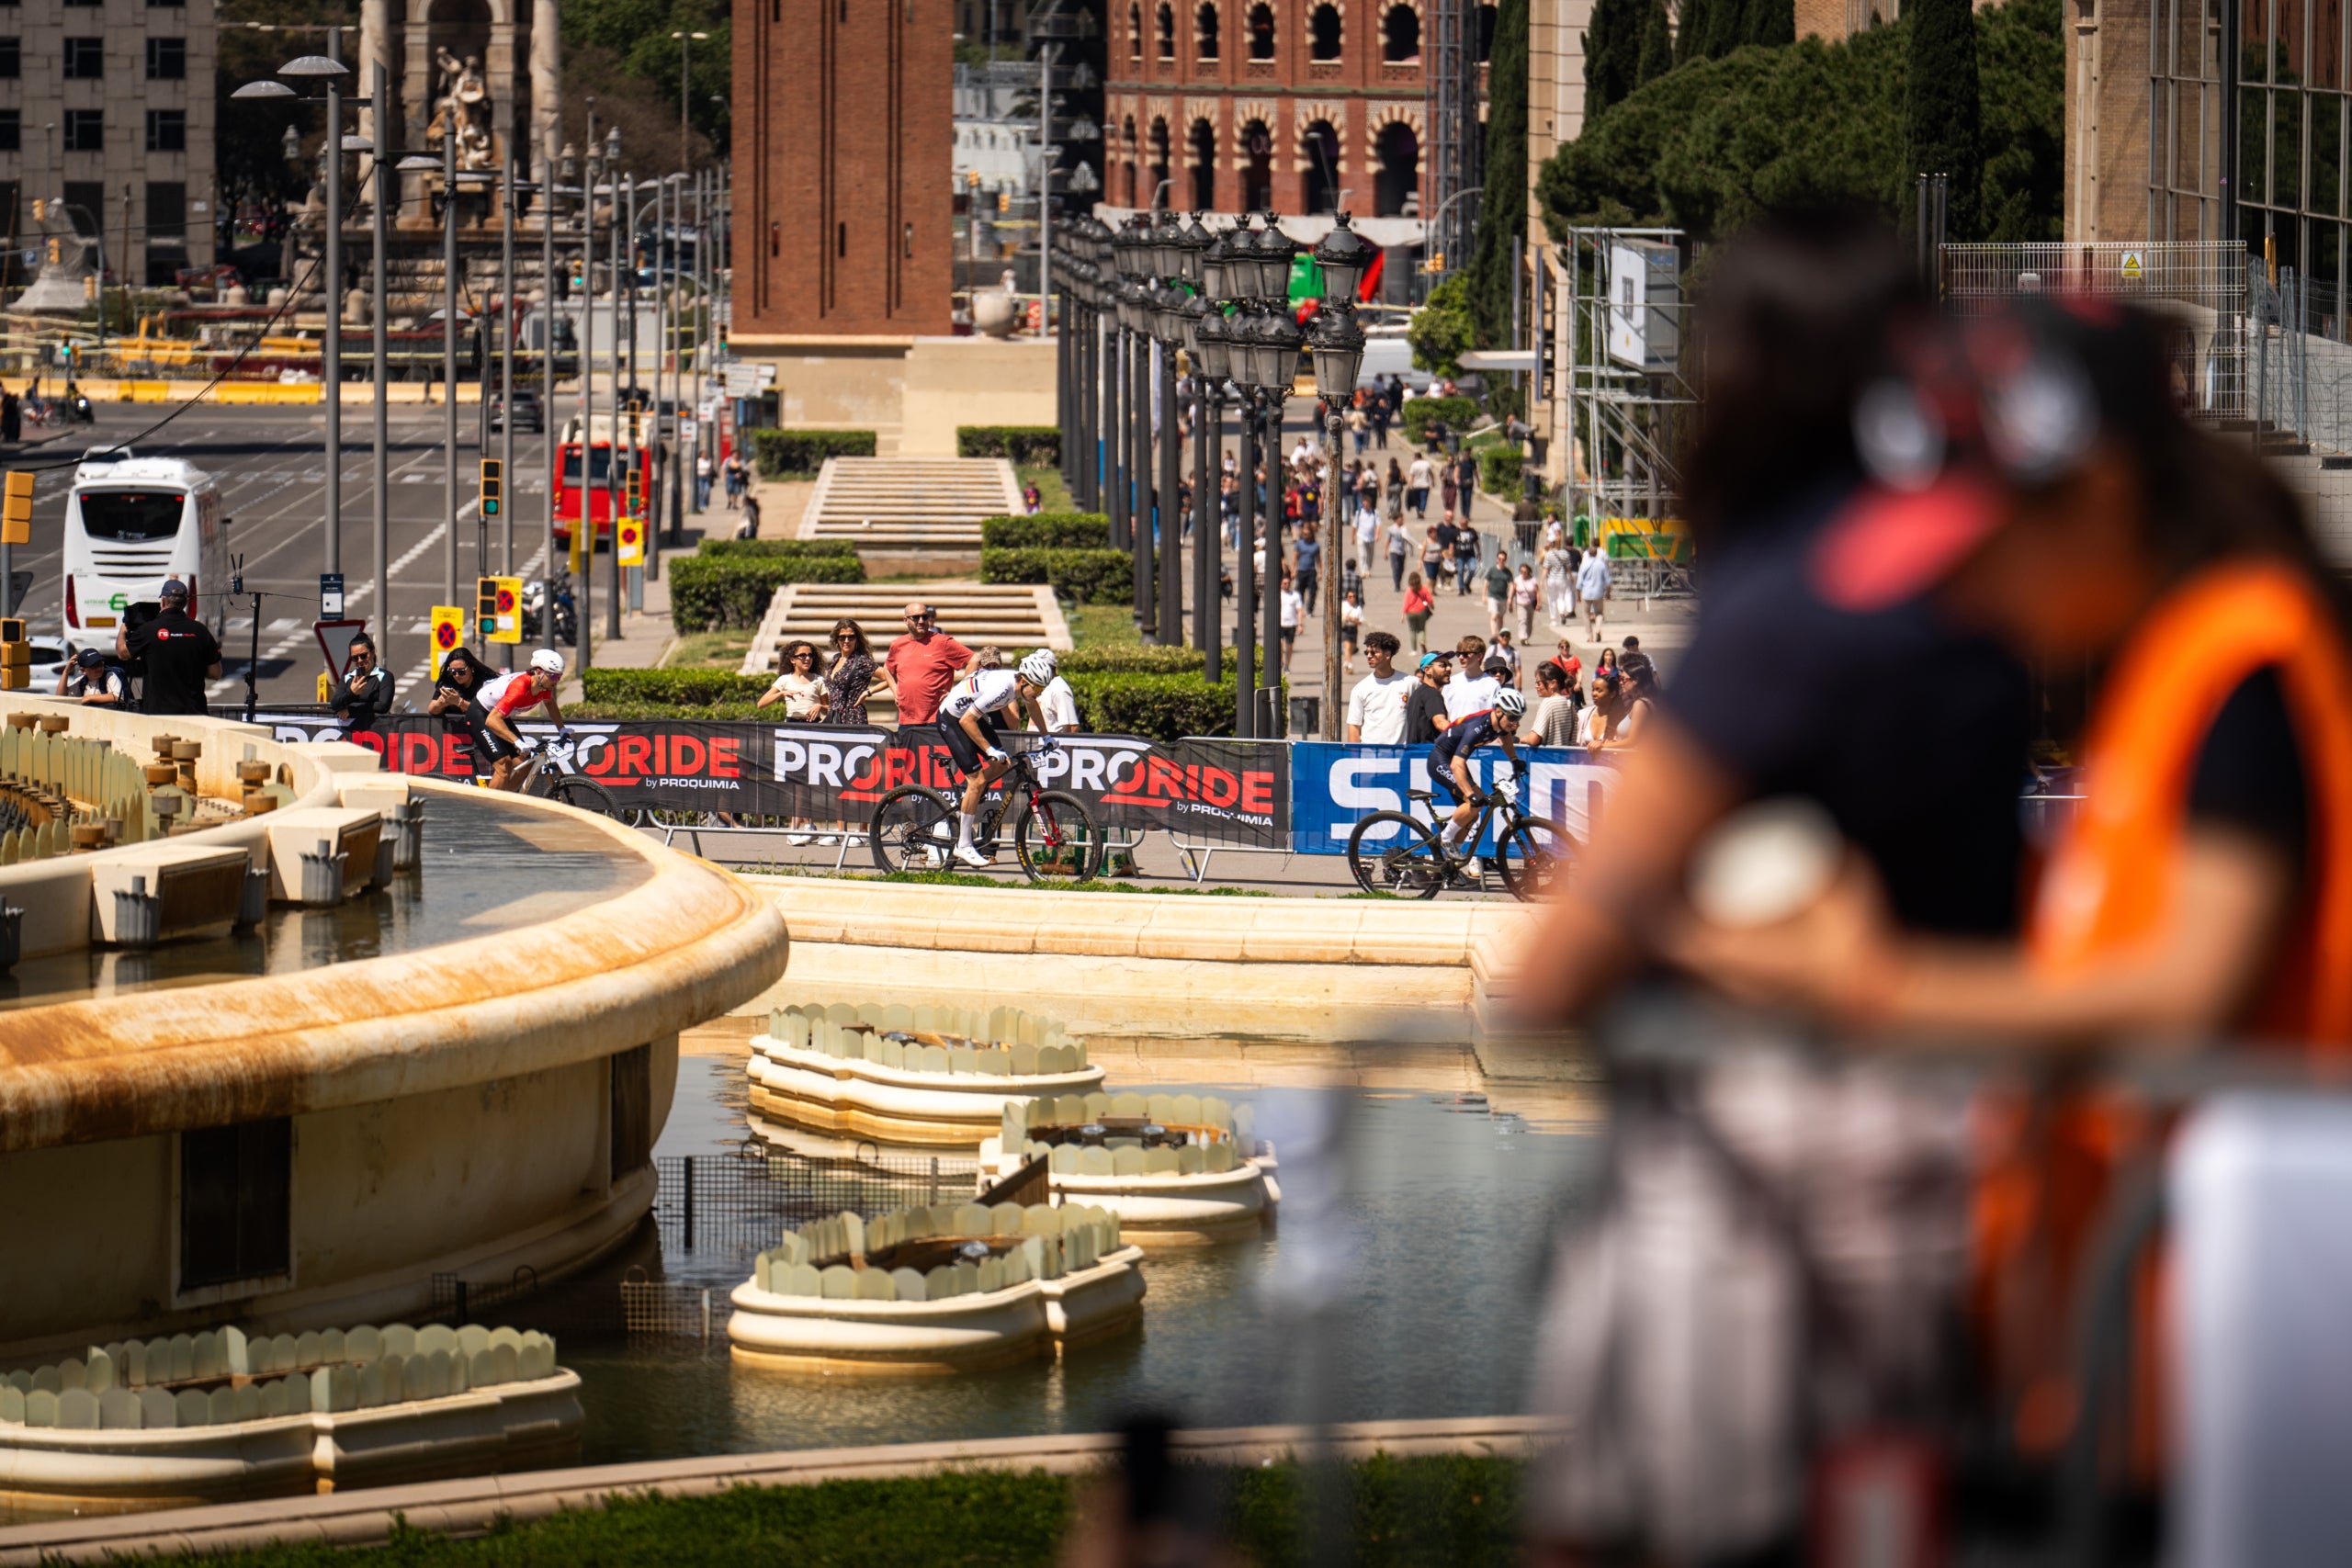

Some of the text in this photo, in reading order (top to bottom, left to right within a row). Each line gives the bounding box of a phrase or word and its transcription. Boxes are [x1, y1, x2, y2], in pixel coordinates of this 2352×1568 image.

[646, 777, 741, 790] by PROQUIMIA
[1038, 749, 1274, 814] PRORIDE
[911, 794, 923, 804] by
[1177, 801, 1189, 813] by
